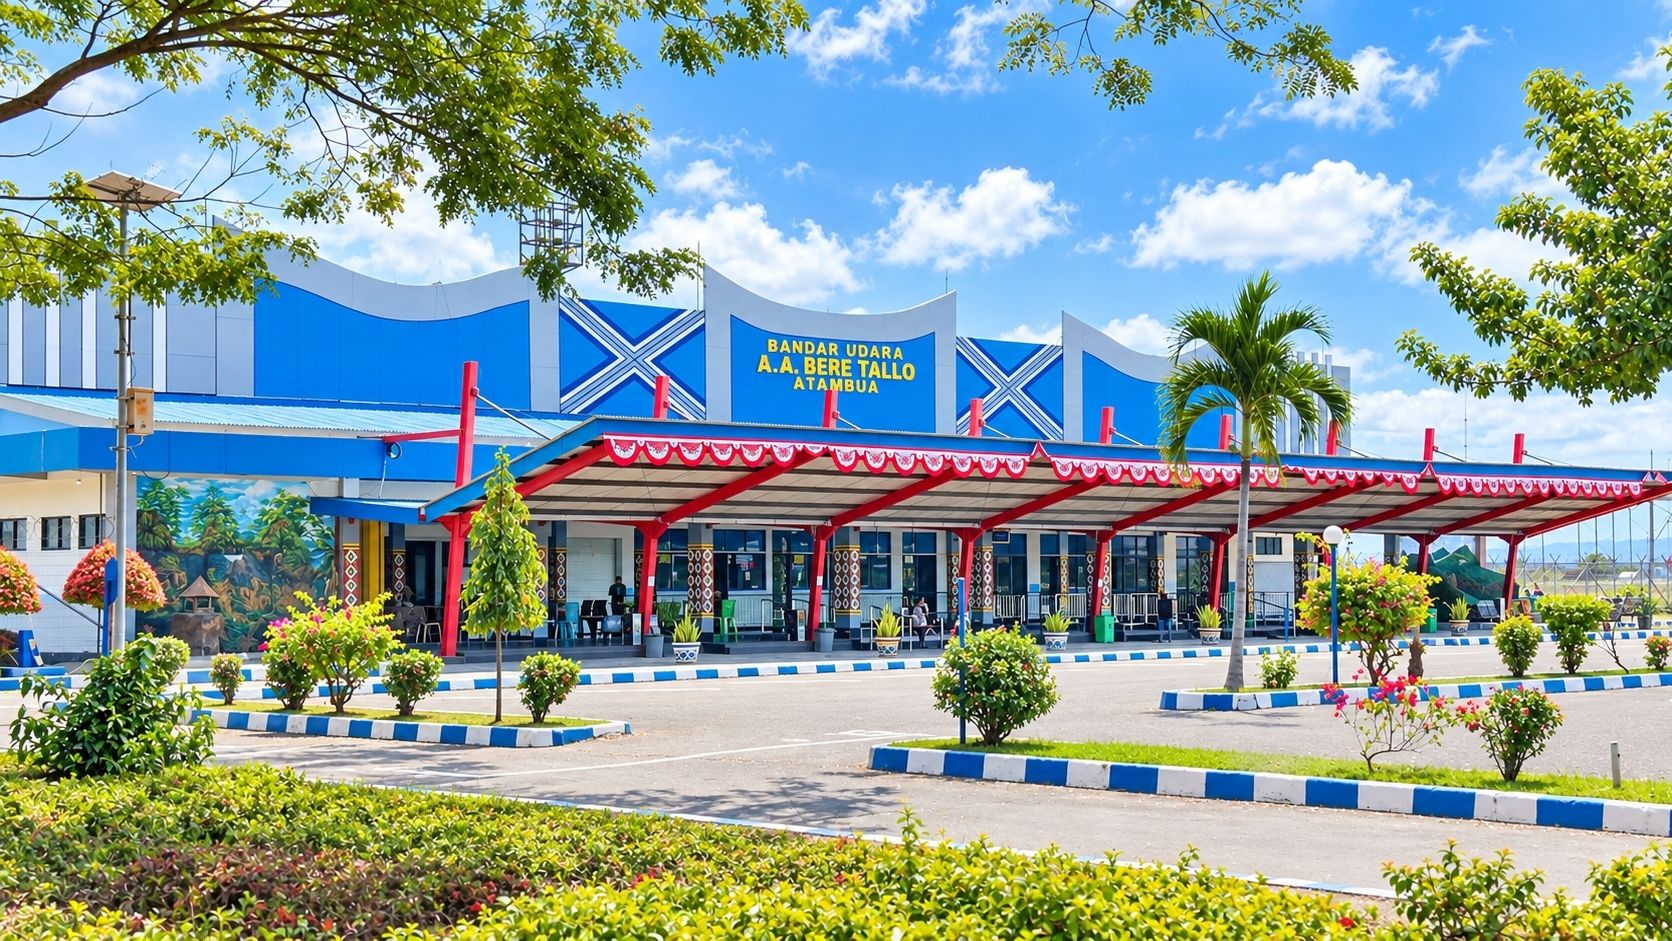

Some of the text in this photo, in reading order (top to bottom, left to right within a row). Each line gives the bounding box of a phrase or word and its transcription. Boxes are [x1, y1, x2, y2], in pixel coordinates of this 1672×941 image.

[767, 339, 904, 360] BANDAR UDARA
[757, 354, 916, 381] A.A. BERE TALLO
[793, 376, 879, 394] ATAMBUA
